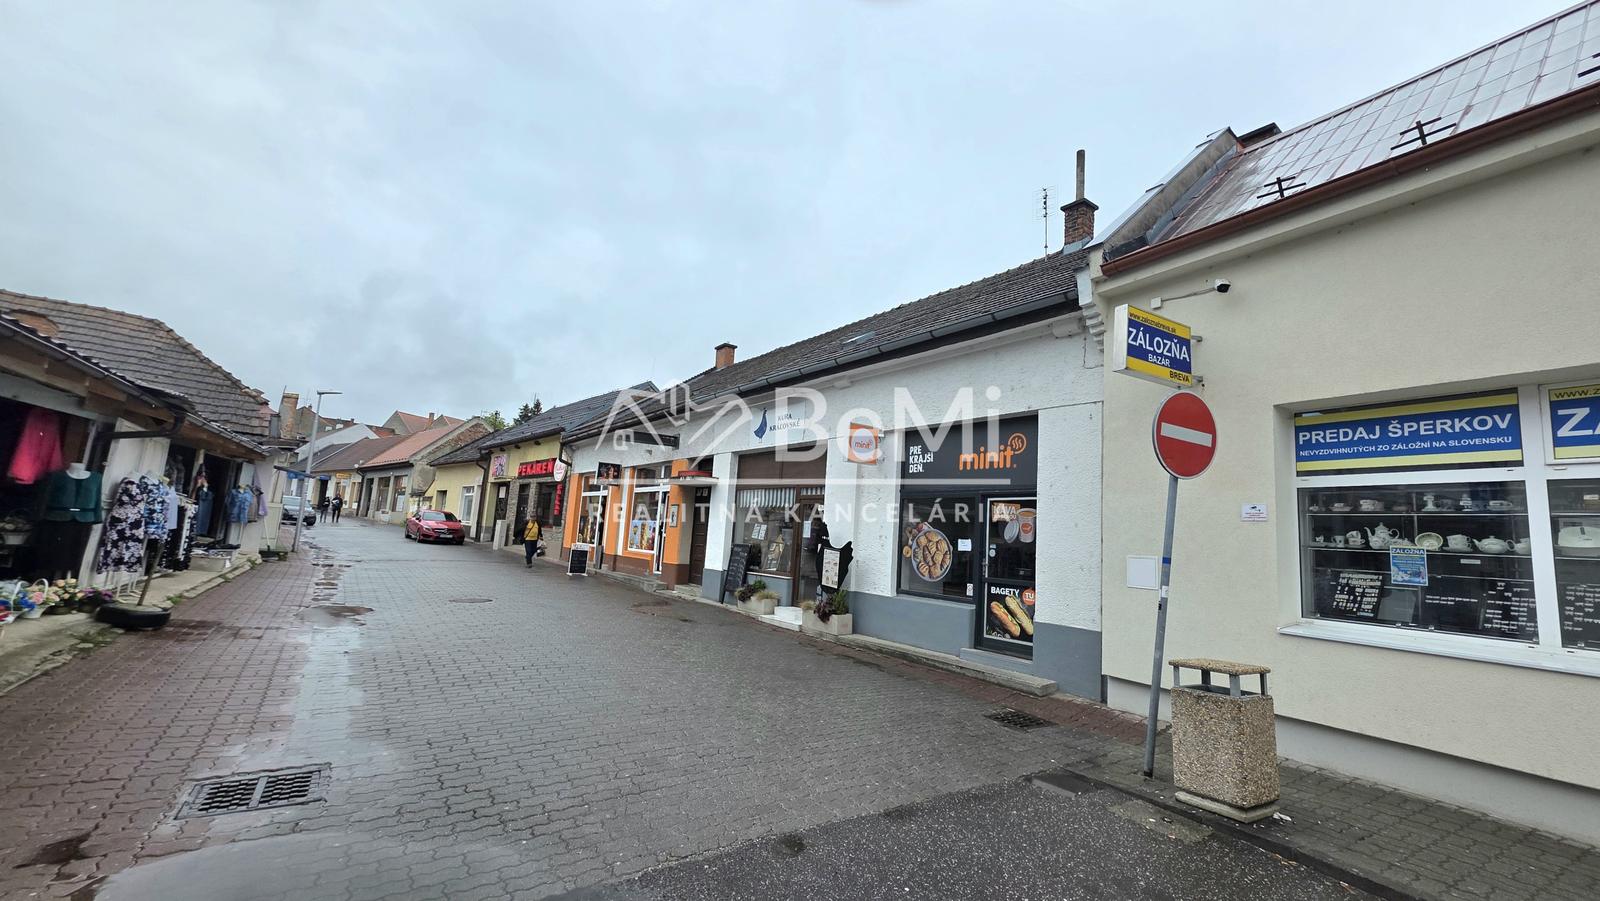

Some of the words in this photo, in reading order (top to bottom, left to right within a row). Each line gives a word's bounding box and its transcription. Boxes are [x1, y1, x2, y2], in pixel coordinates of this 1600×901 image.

[1148, 353, 1171, 368] BAZÁR
[1169, 370, 1190, 383] BREVA
[1299, 425, 1380, 444] PREDAJ
[1388, 413, 1512, 438] ŠPERKOV
[1557, 407, 1600, 438] Z
[909, 445, 922, 455] PRE
[1300, 445, 1376, 457] NEVYZDVIHNUTÝCH
[1377, 444, 1390, 452] ZO
[1391, 441, 1431, 450] ZÁLOŽNÍ
[1432, 440, 1447, 448] NA
[1448, 436, 1513, 447] SLOVENSKU
[909, 451, 934, 464] KRAJŠÍ
[991, 587, 1019, 597] BAGETY
